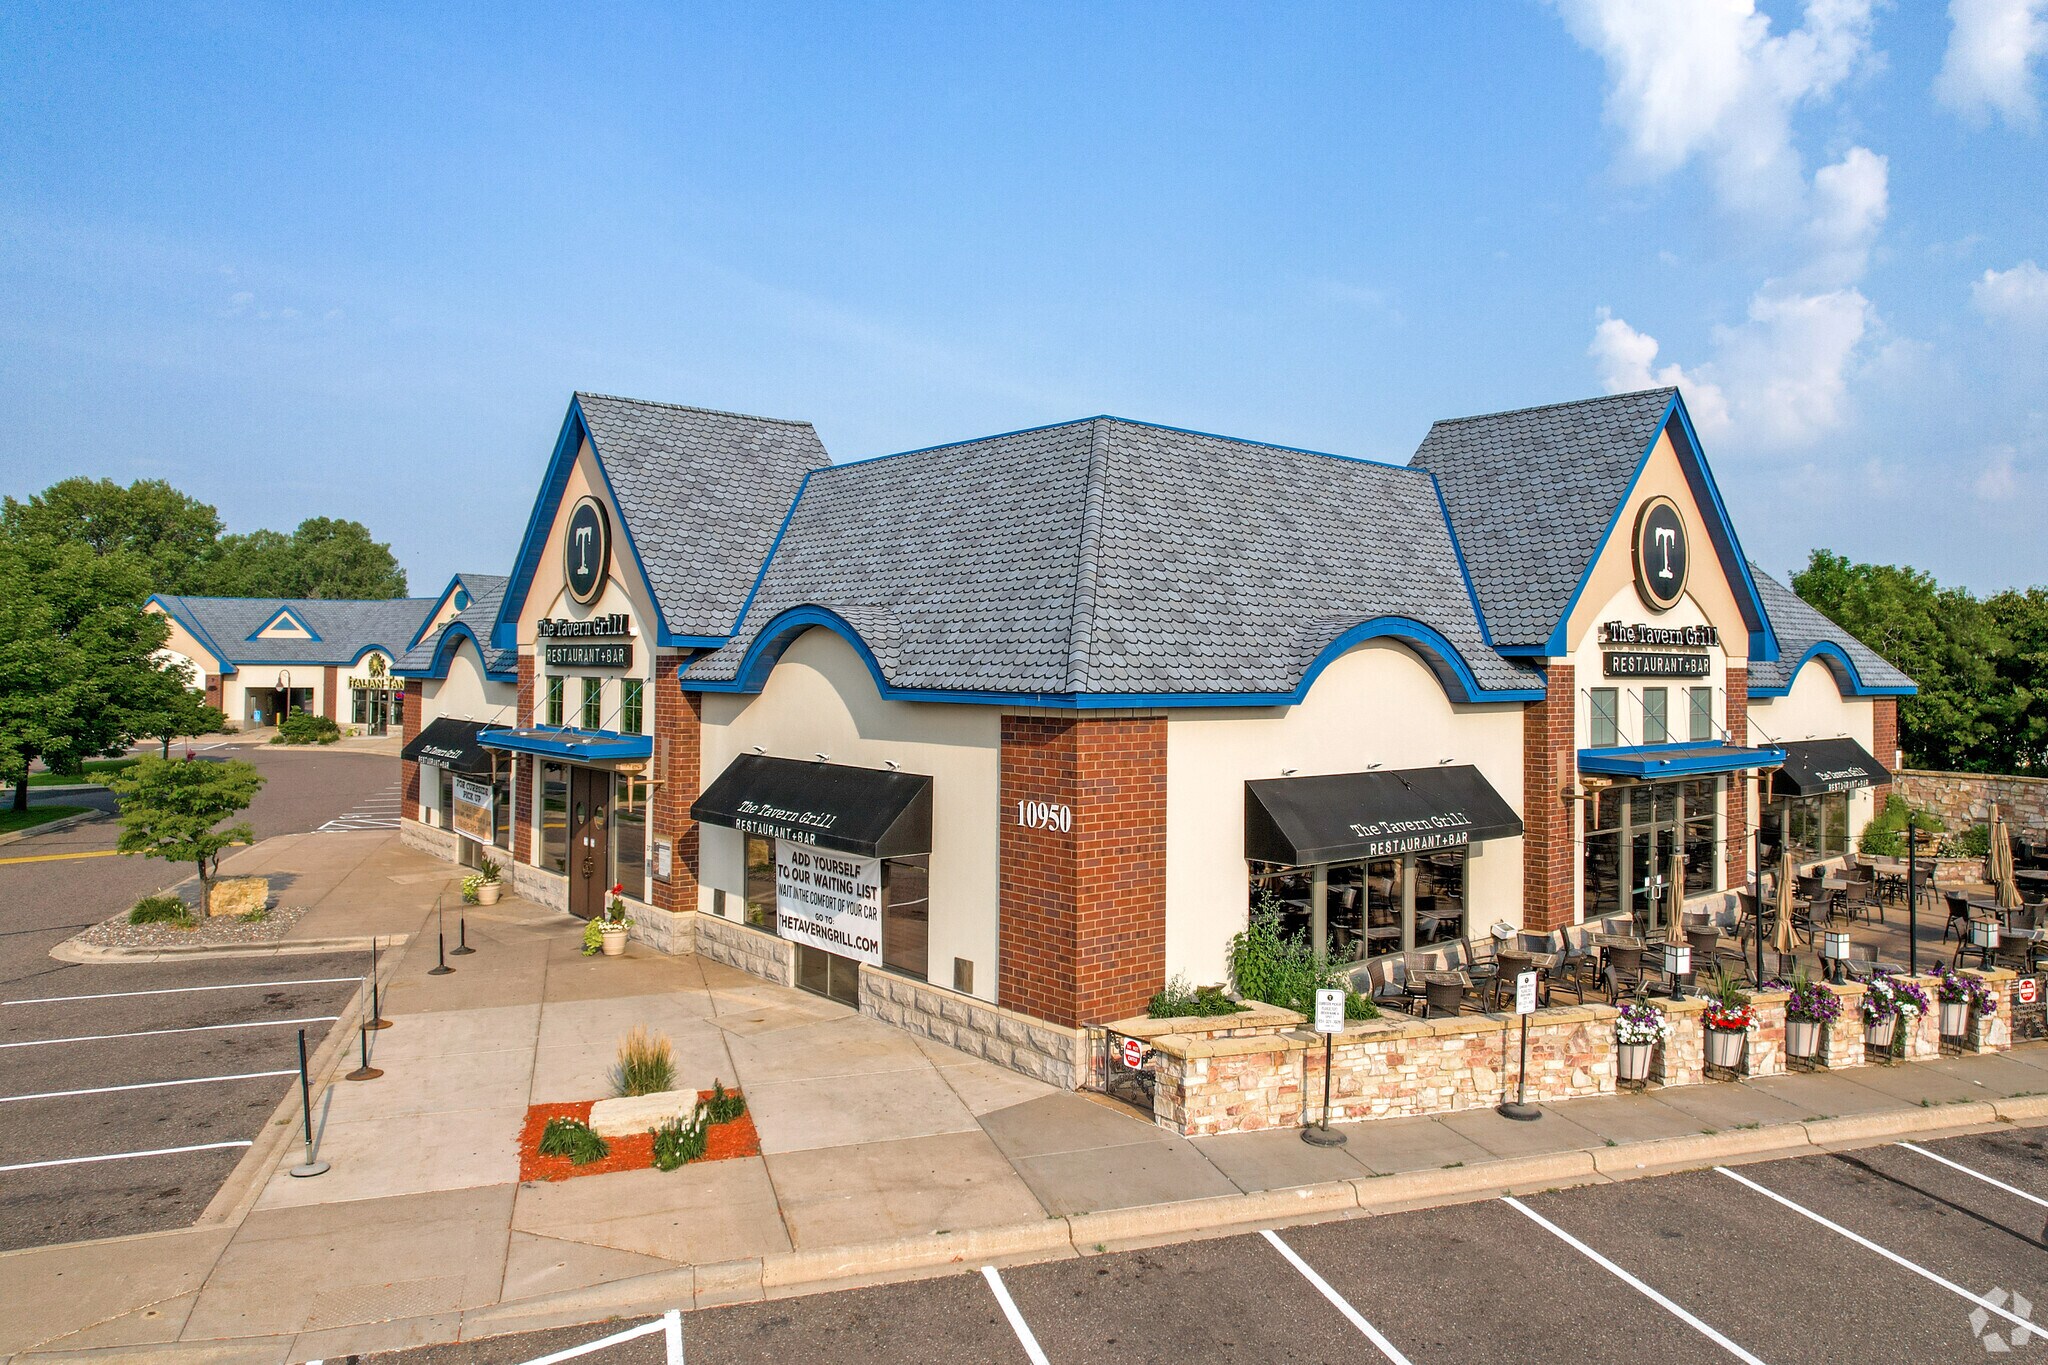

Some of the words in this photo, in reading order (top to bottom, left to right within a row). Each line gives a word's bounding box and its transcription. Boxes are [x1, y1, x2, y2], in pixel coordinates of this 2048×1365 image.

[576, 526, 592, 575] T
[1655, 527, 1675, 579] T
[538, 619, 554, 637] The
[556, 619, 591, 636] Tavern
[593, 614, 625, 636] Grill
[1610, 622, 1635, 641] The
[1639, 624, 1683, 644] Tavern
[1686, 626, 1719, 646] Grill
[737, 800, 758, 814] The
[757, 804, 799, 822] Tavern
[798, 811, 837, 829] Grill
[1017, 800, 1071, 833] 10950
[1350, 823, 1381, 837] The
[1379, 819, 1433, 834] Tavern
[1431, 812, 1472, 828] Grill
[792, 851, 810, 867] ADD
[813, 855, 861, 879] YOURSELF
[778, 864, 790, 879] TO
[792, 868, 811, 885] OUR
[813, 872, 854, 895] WAITING
[856, 883, 877, 901] LIST
[778, 883, 792, 898] WAIT
[793, 886, 799, 900] IN
[799, 888, 809, 903] THE
[809, 890, 837, 910] COMFORT
[837, 898, 845, 912] OF
[846, 900, 863, 916] YOUR
[863, 905, 877, 921] CAR
[815, 913, 823, 922] GO
[825, 915, 835, 925] TO:
